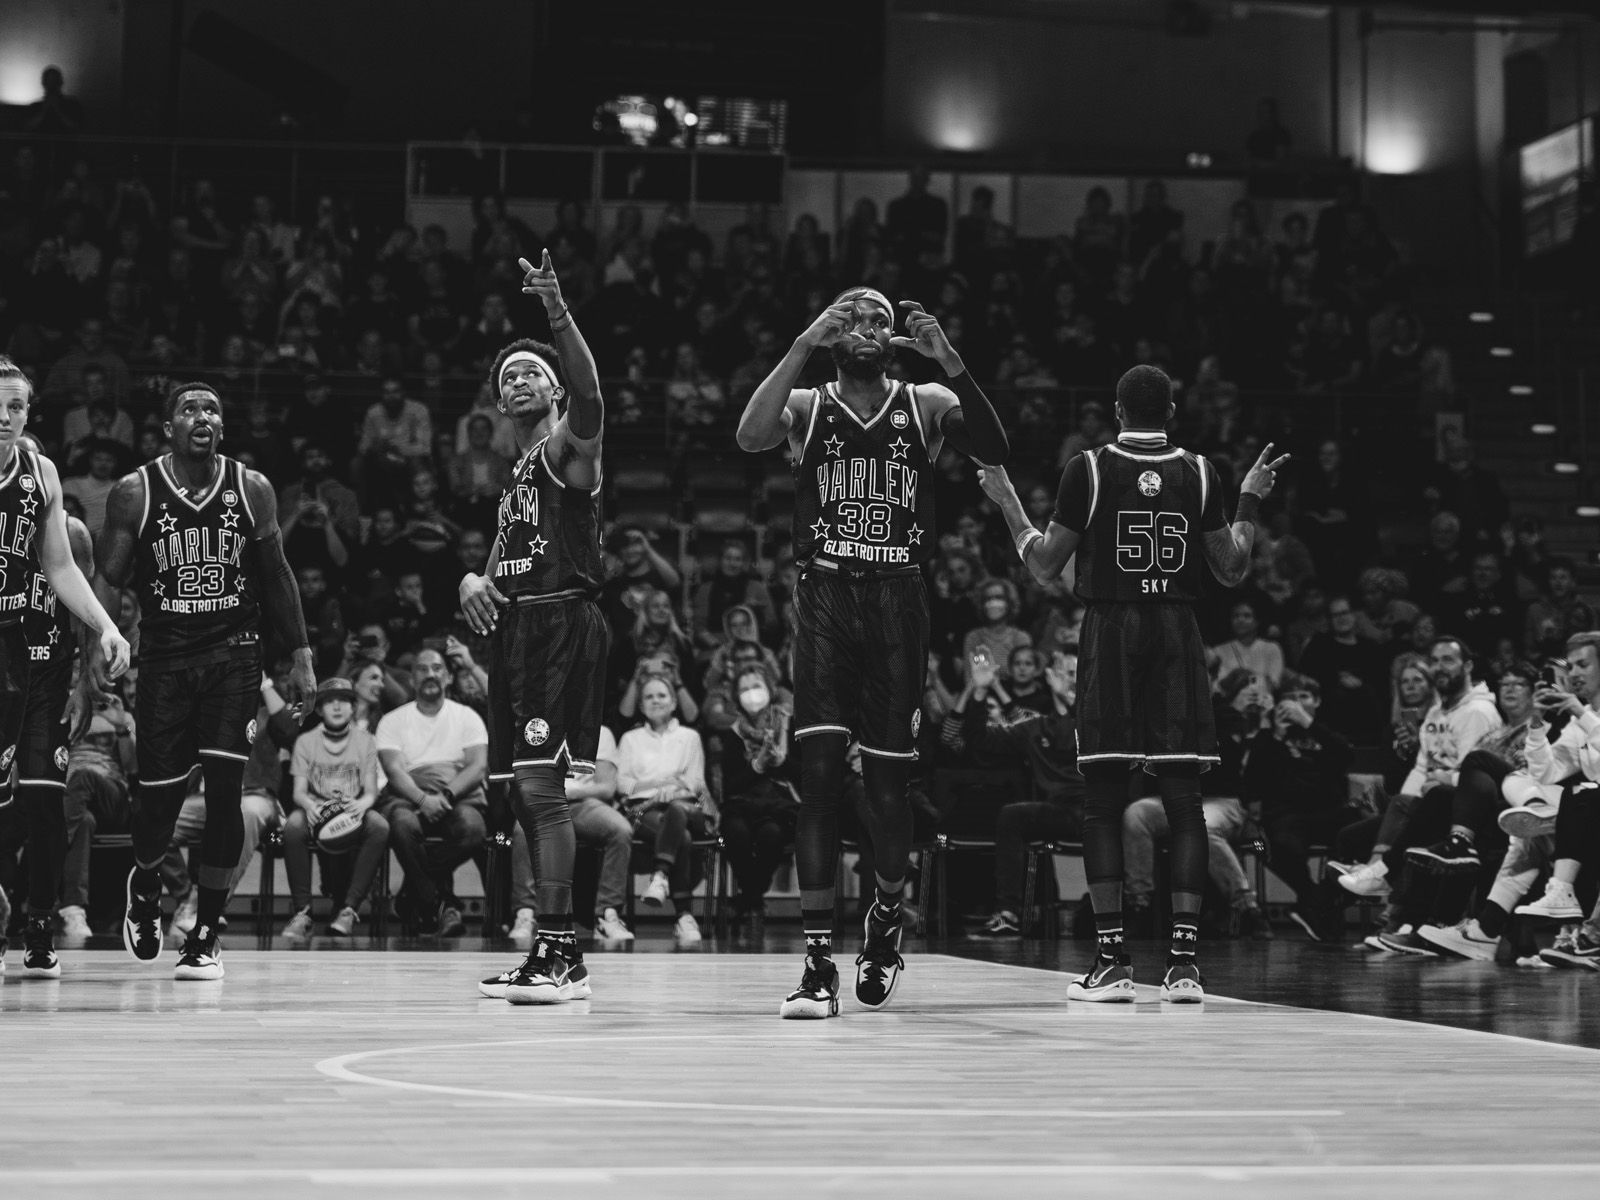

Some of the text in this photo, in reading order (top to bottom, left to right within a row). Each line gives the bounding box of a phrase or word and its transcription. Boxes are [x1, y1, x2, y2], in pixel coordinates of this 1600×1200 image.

[816, 457, 918, 513] HARLEM
[837, 501, 892, 542] 38
[1116, 510, 1189, 573] 56
[495, 557, 533, 578] OTTERS
[178, 563, 225, 598] 23
[1141, 578, 1169, 594] SKY
[0, 591, 28, 612] TTERS
[160, 593, 240, 614] GLOBETROTTERS
[27, 645, 51, 661] ERS
